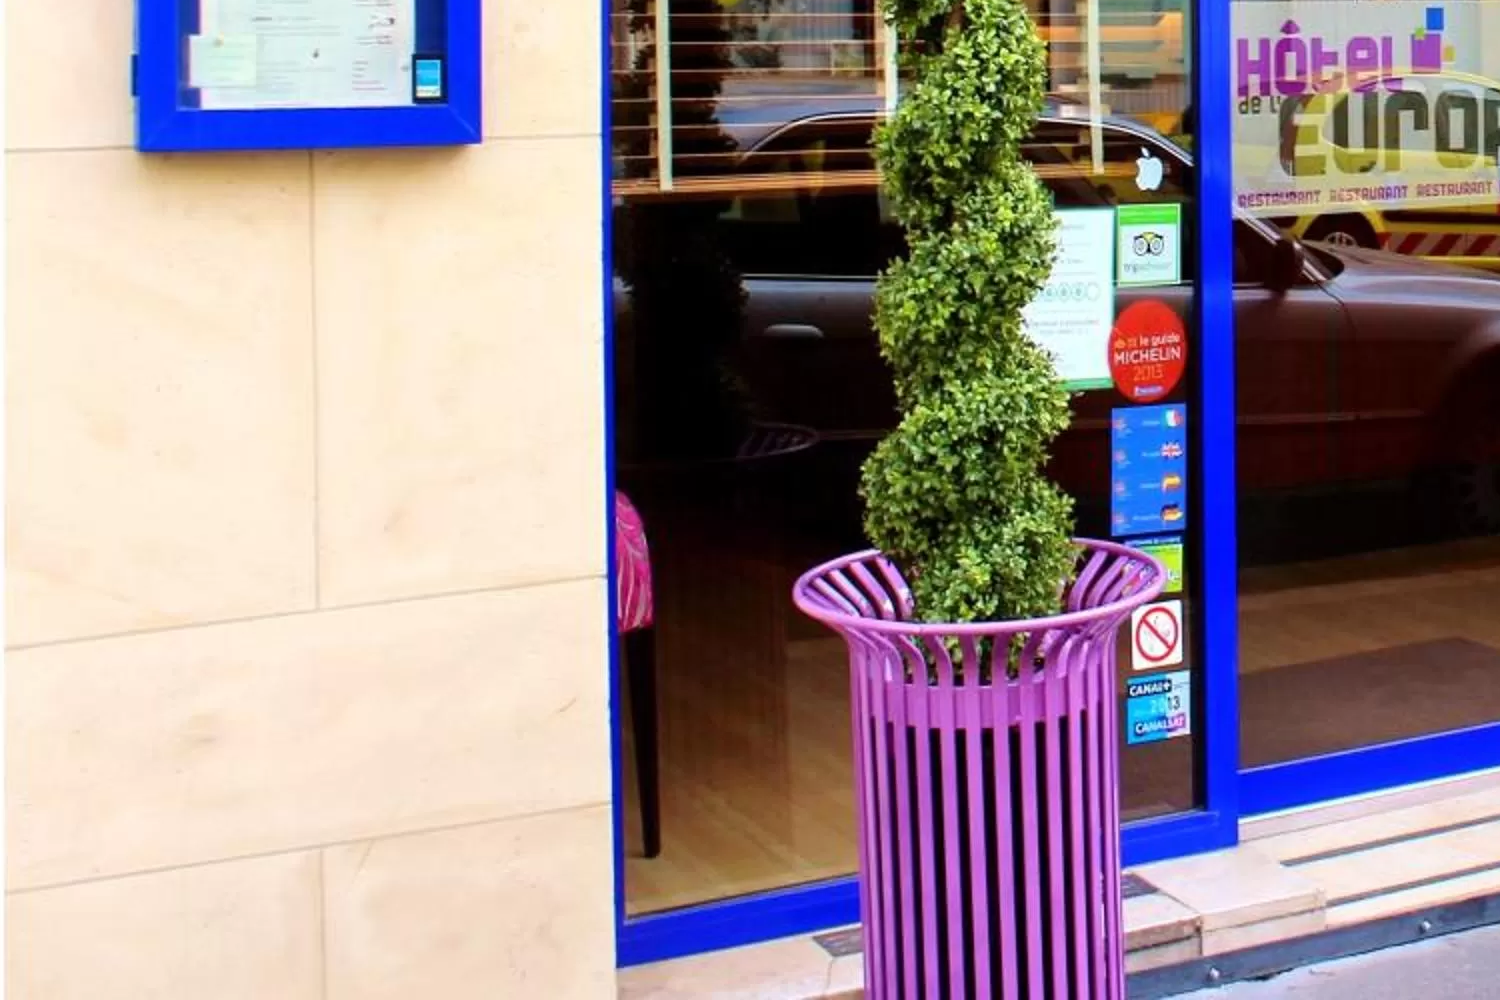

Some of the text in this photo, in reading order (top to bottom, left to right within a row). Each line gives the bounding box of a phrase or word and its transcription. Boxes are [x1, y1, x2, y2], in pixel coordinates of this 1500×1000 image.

[1237, 19, 1404, 95] Hôtel
[1237, 95, 1261, 115] de
[1238, 190, 1321, 208] RESTAURANT
[1330, 185, 1408, 203] RESTAURANT
[1416, 180, 1493, 197] RESTAURANT
[1114, 345, 1181, 365] MICHELIN
[1133, 363, 1164, 381] 2013
